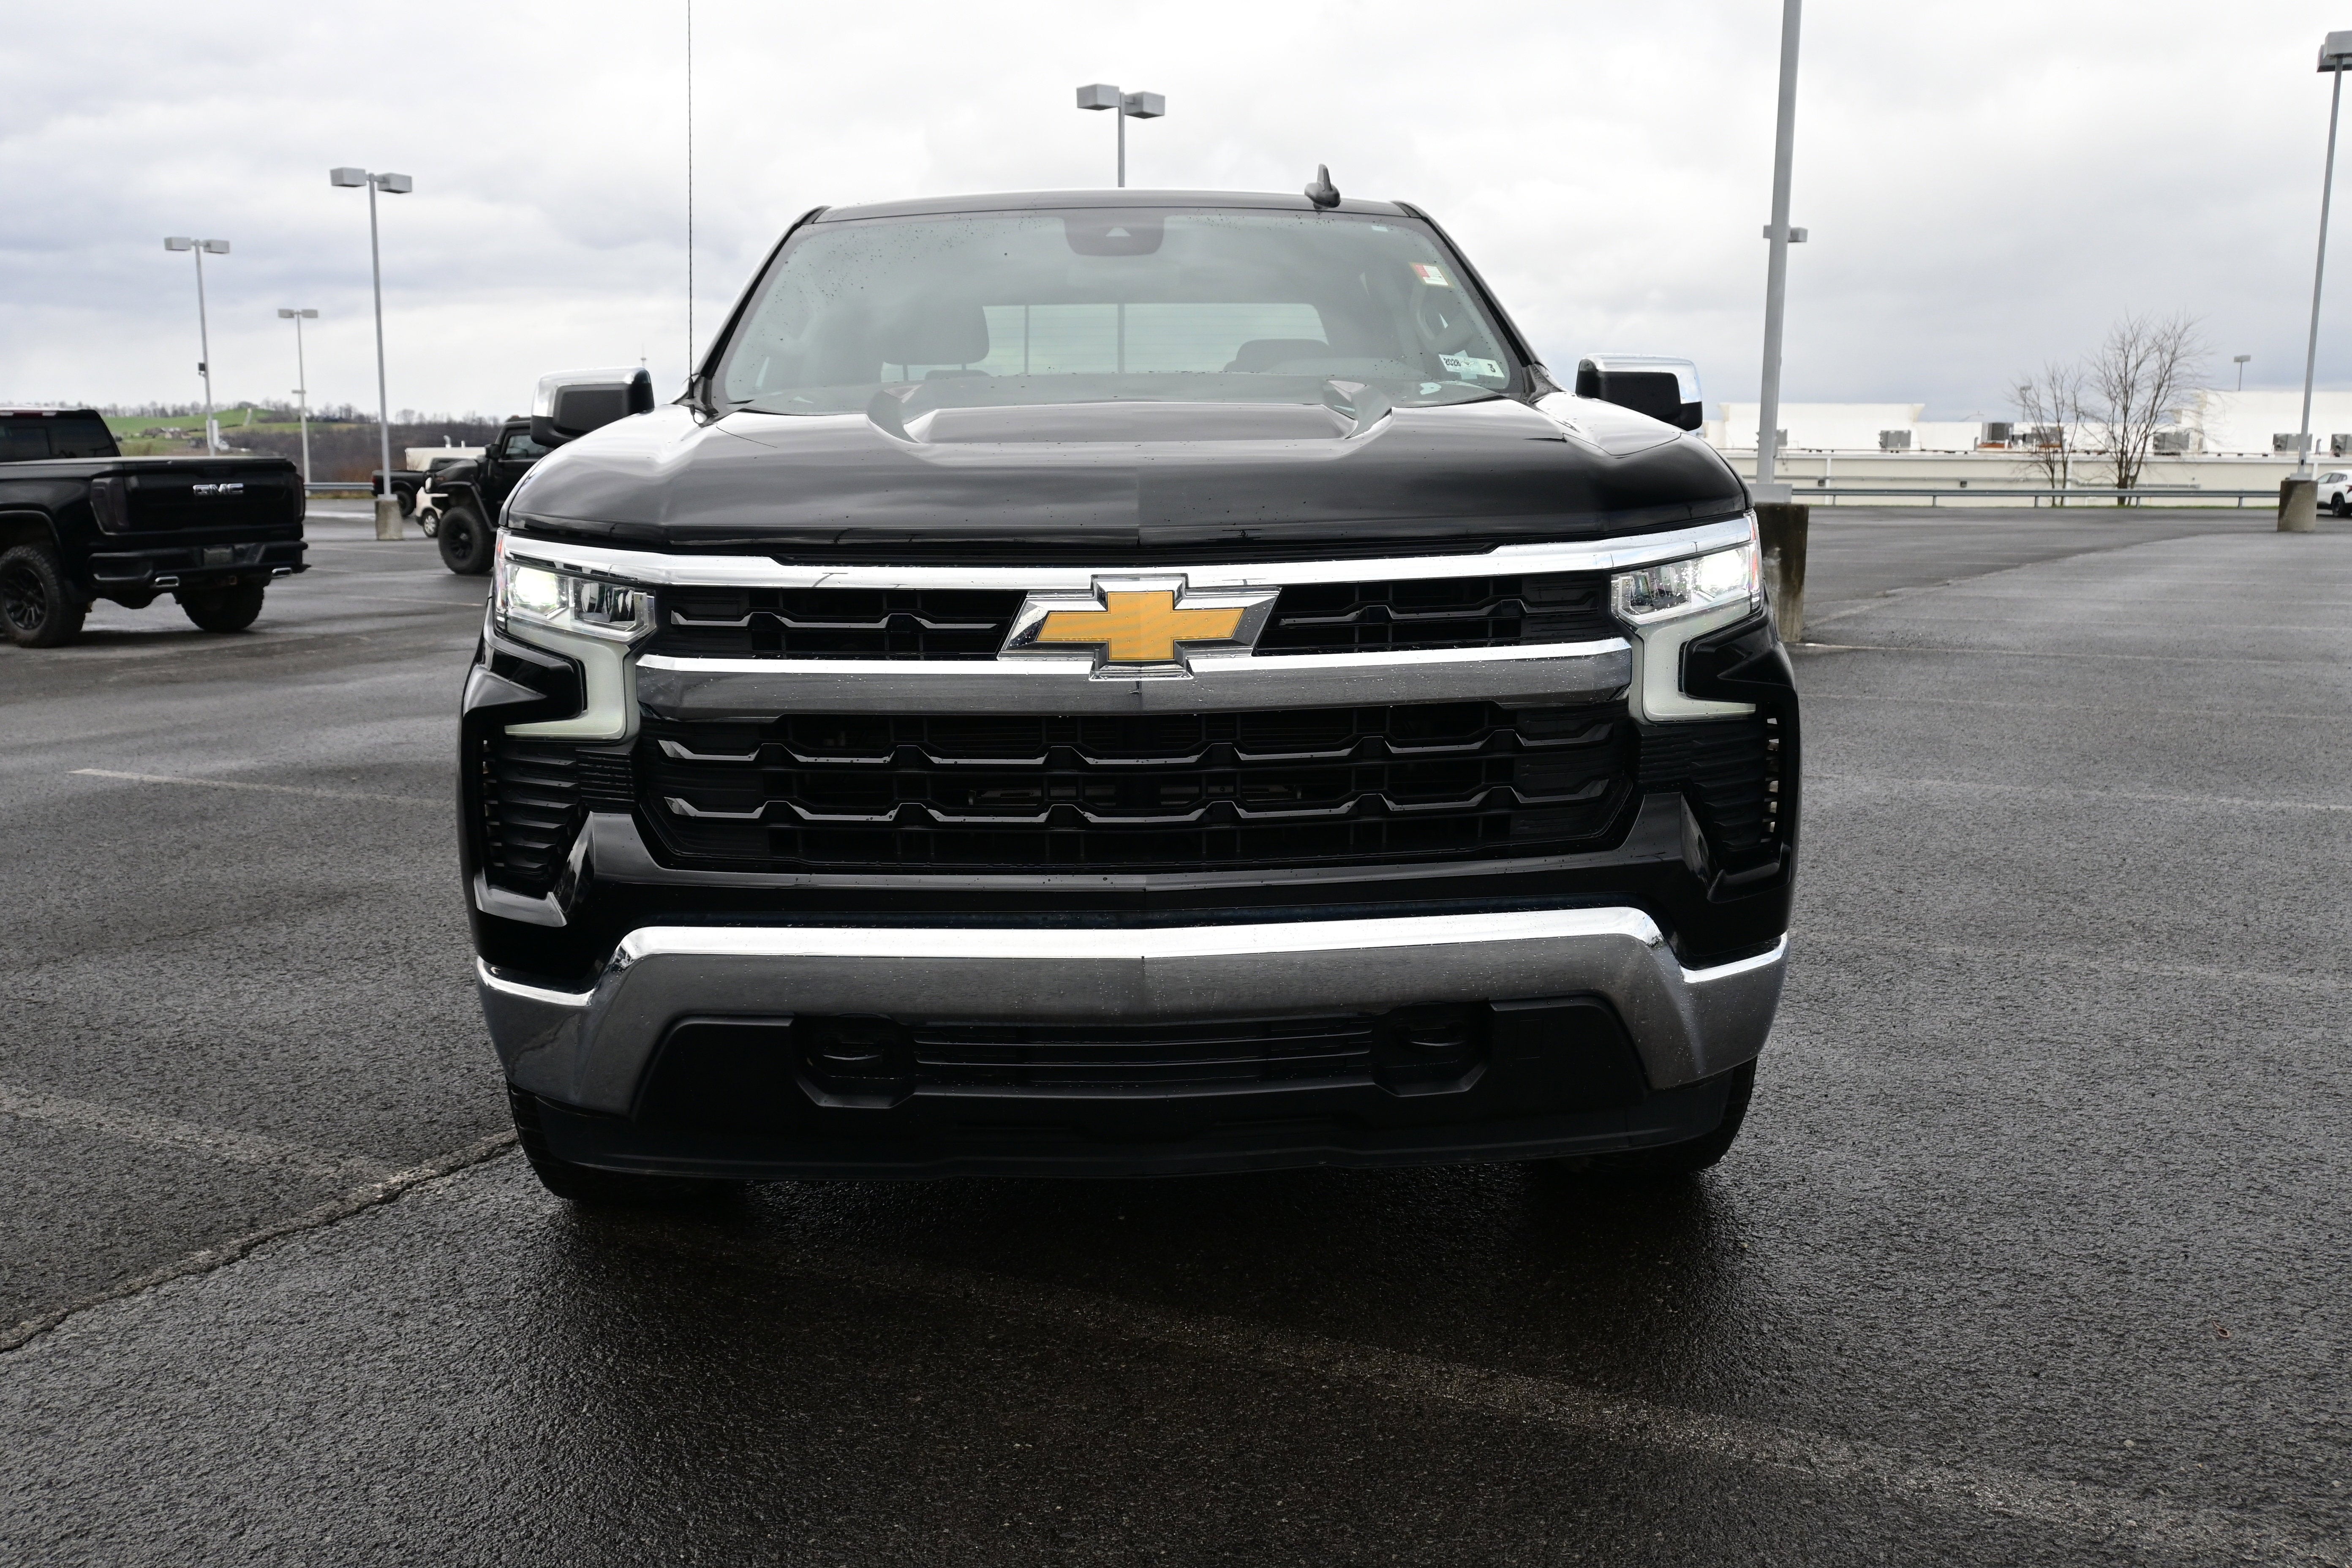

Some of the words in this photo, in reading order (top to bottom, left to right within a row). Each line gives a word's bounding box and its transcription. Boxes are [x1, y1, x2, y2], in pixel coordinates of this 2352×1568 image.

[1443, 358, 1461, 367] 2028
[1487, 363, 1496, 373] 3
[193, 483, 244, 495] GMC
